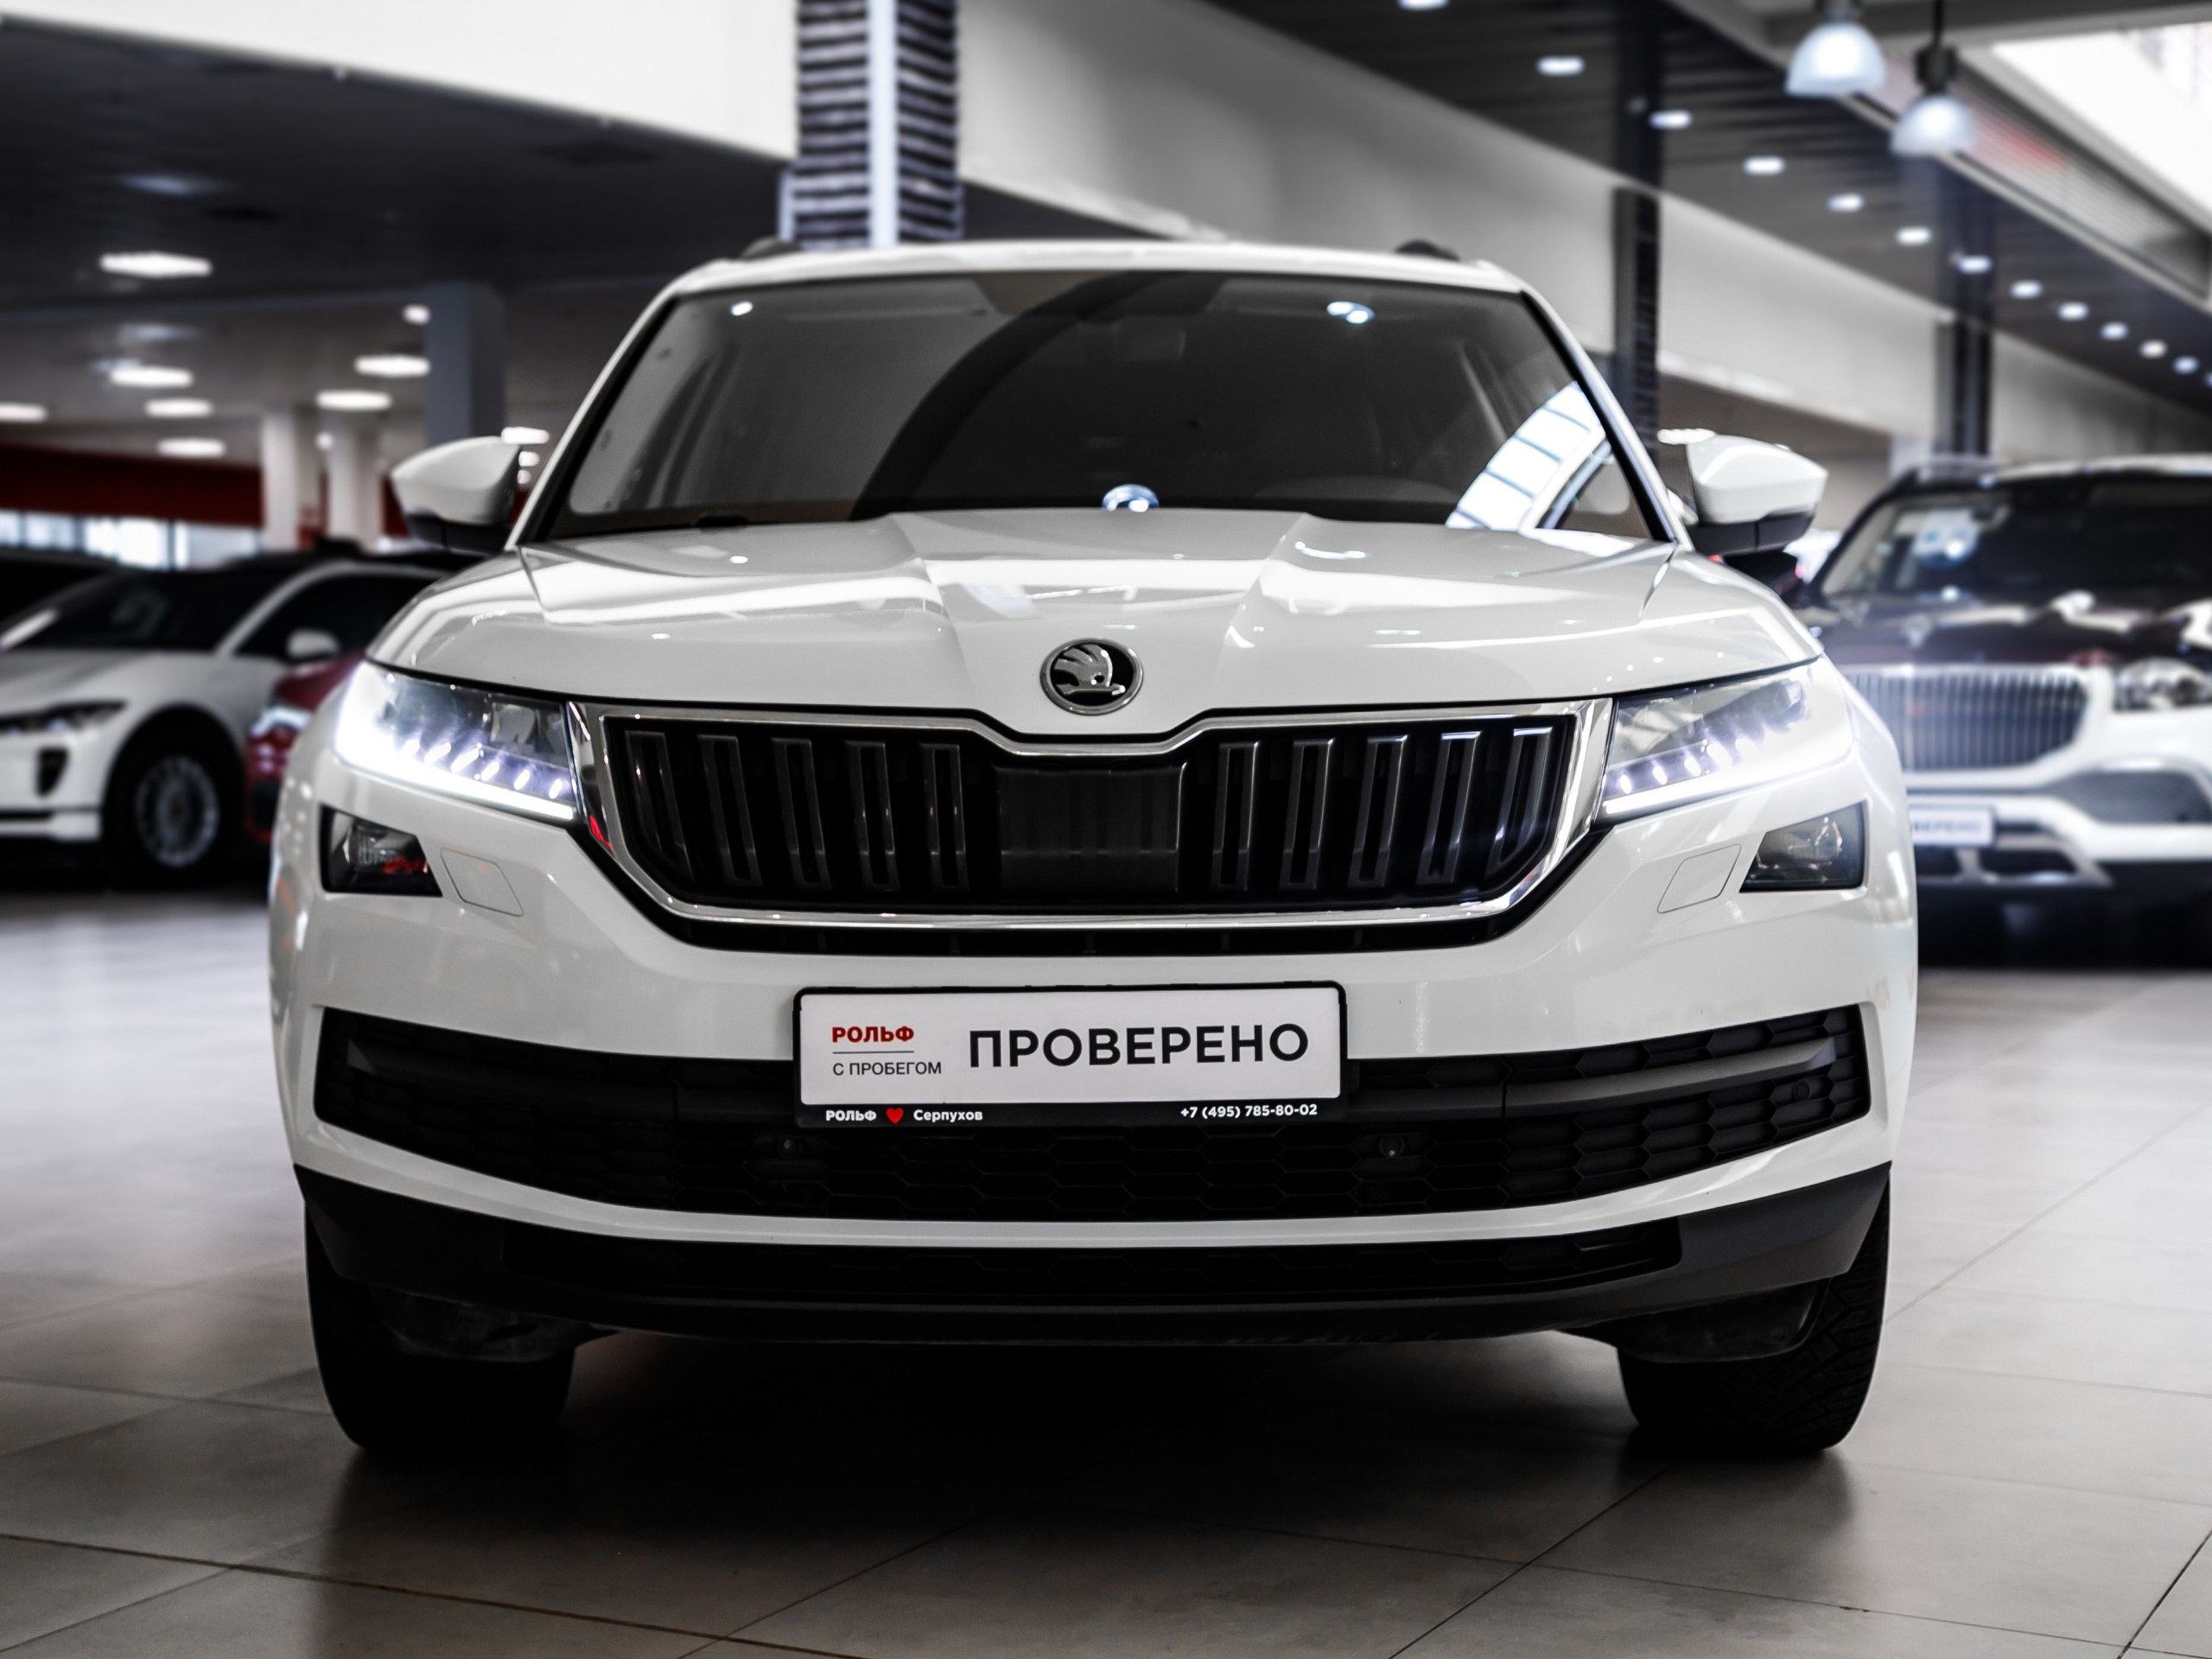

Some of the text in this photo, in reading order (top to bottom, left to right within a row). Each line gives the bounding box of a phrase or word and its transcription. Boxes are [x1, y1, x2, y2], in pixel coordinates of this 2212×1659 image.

[831, 1026, 915, 1043] РОЛЬФ
[969, 1023, 1309, 1068] ПРОВЕРЕНО
[832, 1061, 942, 1077] С ПРОБЕГОМ
[825, 1109, 983, 1123] РОЛЬФ Серпухов
[1180, 1103, 1318, 1120] +7 (495) 785-80-02
